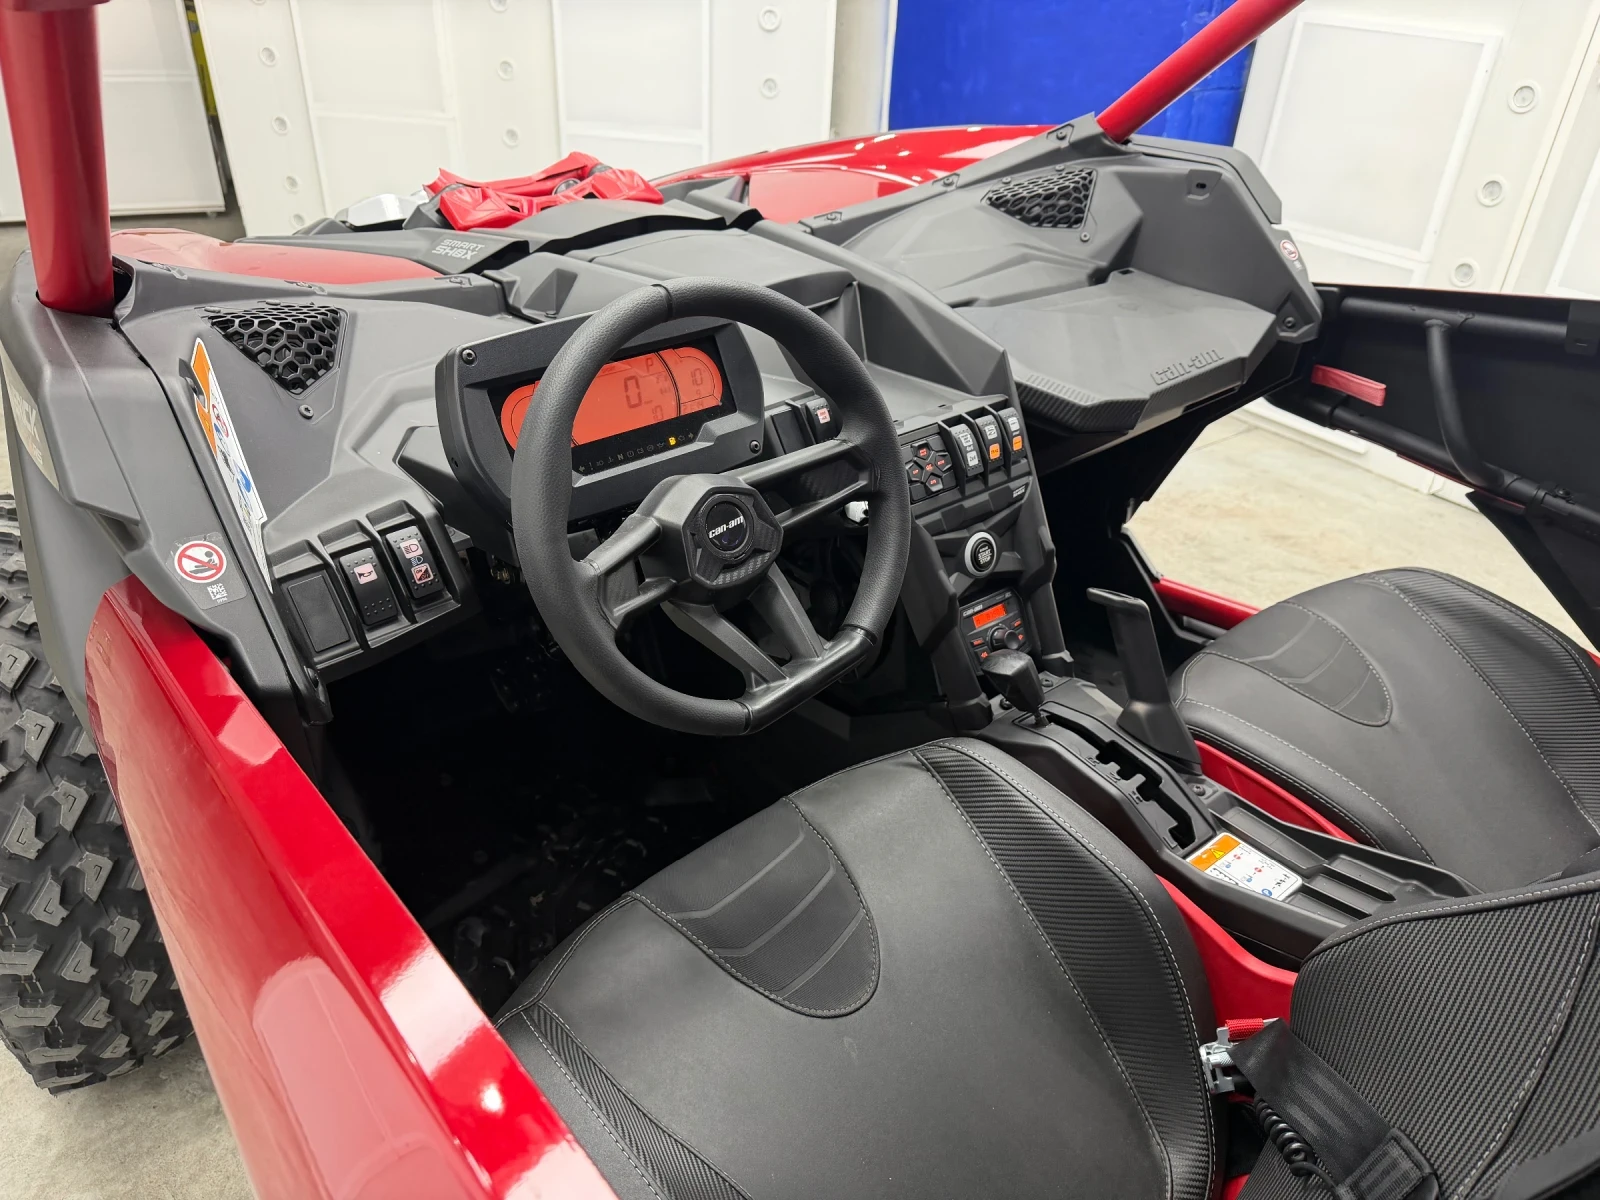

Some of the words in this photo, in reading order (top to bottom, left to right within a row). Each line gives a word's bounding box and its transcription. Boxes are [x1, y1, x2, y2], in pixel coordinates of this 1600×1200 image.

[432, 246, 478, 260] SHOX
[440, 239, 485, 251] SMART
[645, 357, 654, 373] P
[1150, 349, 1224, 386] can-am
[623, 375, 642, 409] 0
[708, 515, 744, 539] can-am
